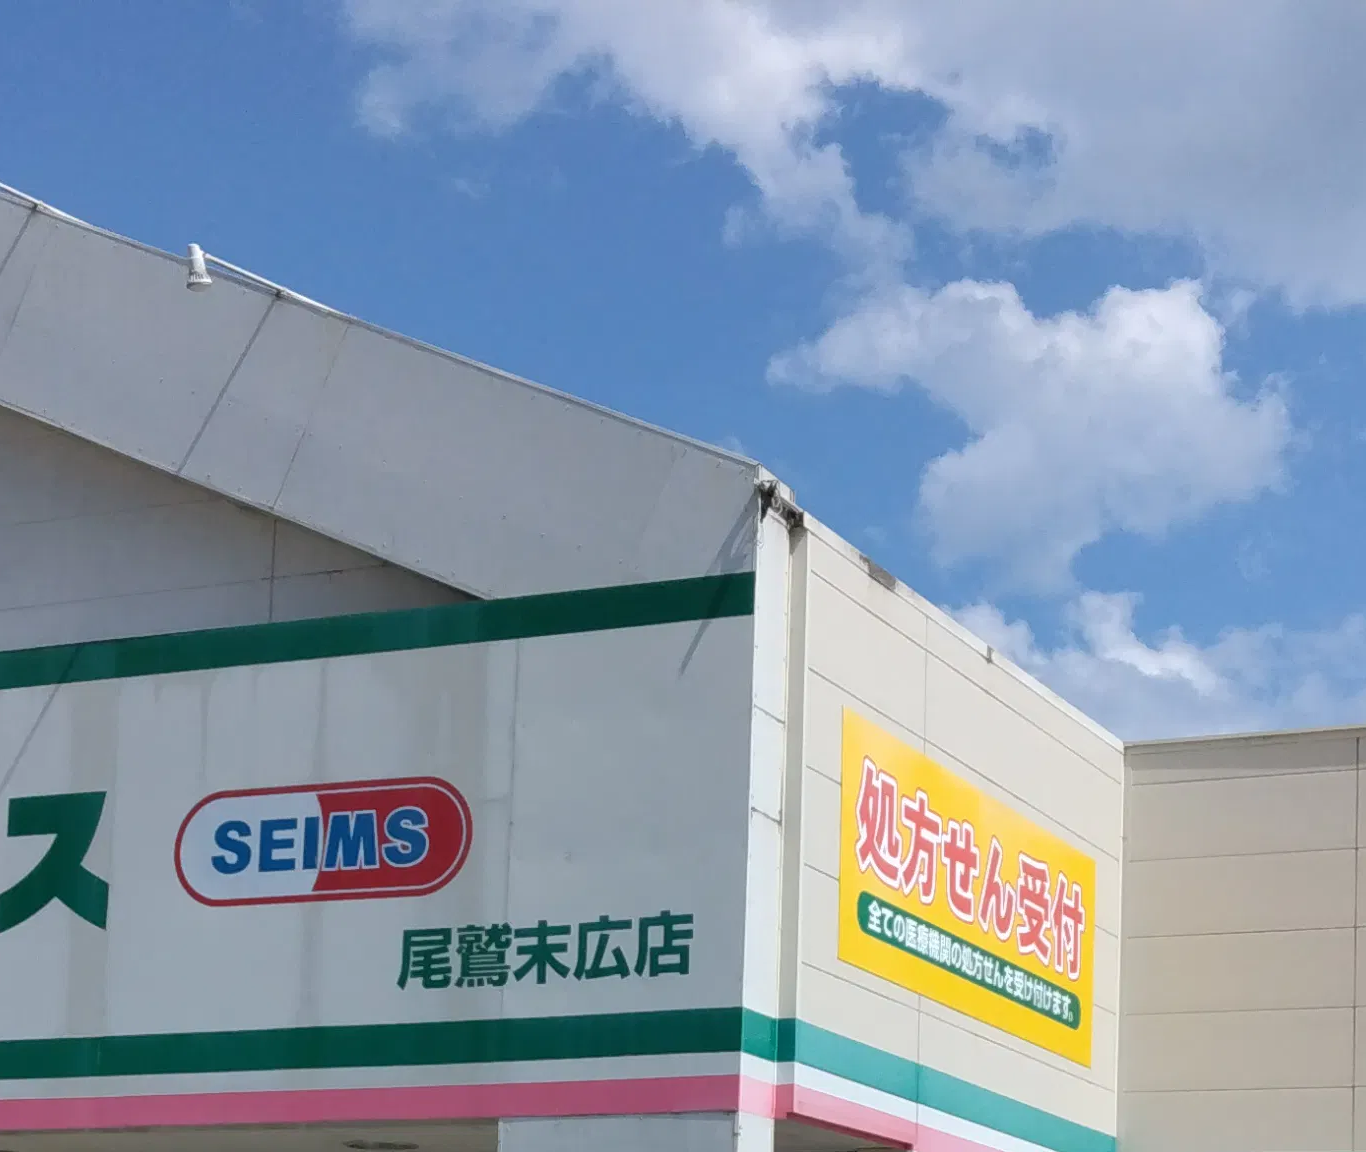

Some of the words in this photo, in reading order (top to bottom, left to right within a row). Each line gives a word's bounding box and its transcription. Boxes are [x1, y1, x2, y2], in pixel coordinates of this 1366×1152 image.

[210, 805, 430, 875] SEIMS
[855, 755, 1085, 980] 処方せん受付
[396, 910, 695, 990] 尾鷲末広店
[867, 899, 1075, 1023] 全ての医療機関の処方せんを受け付けます。
